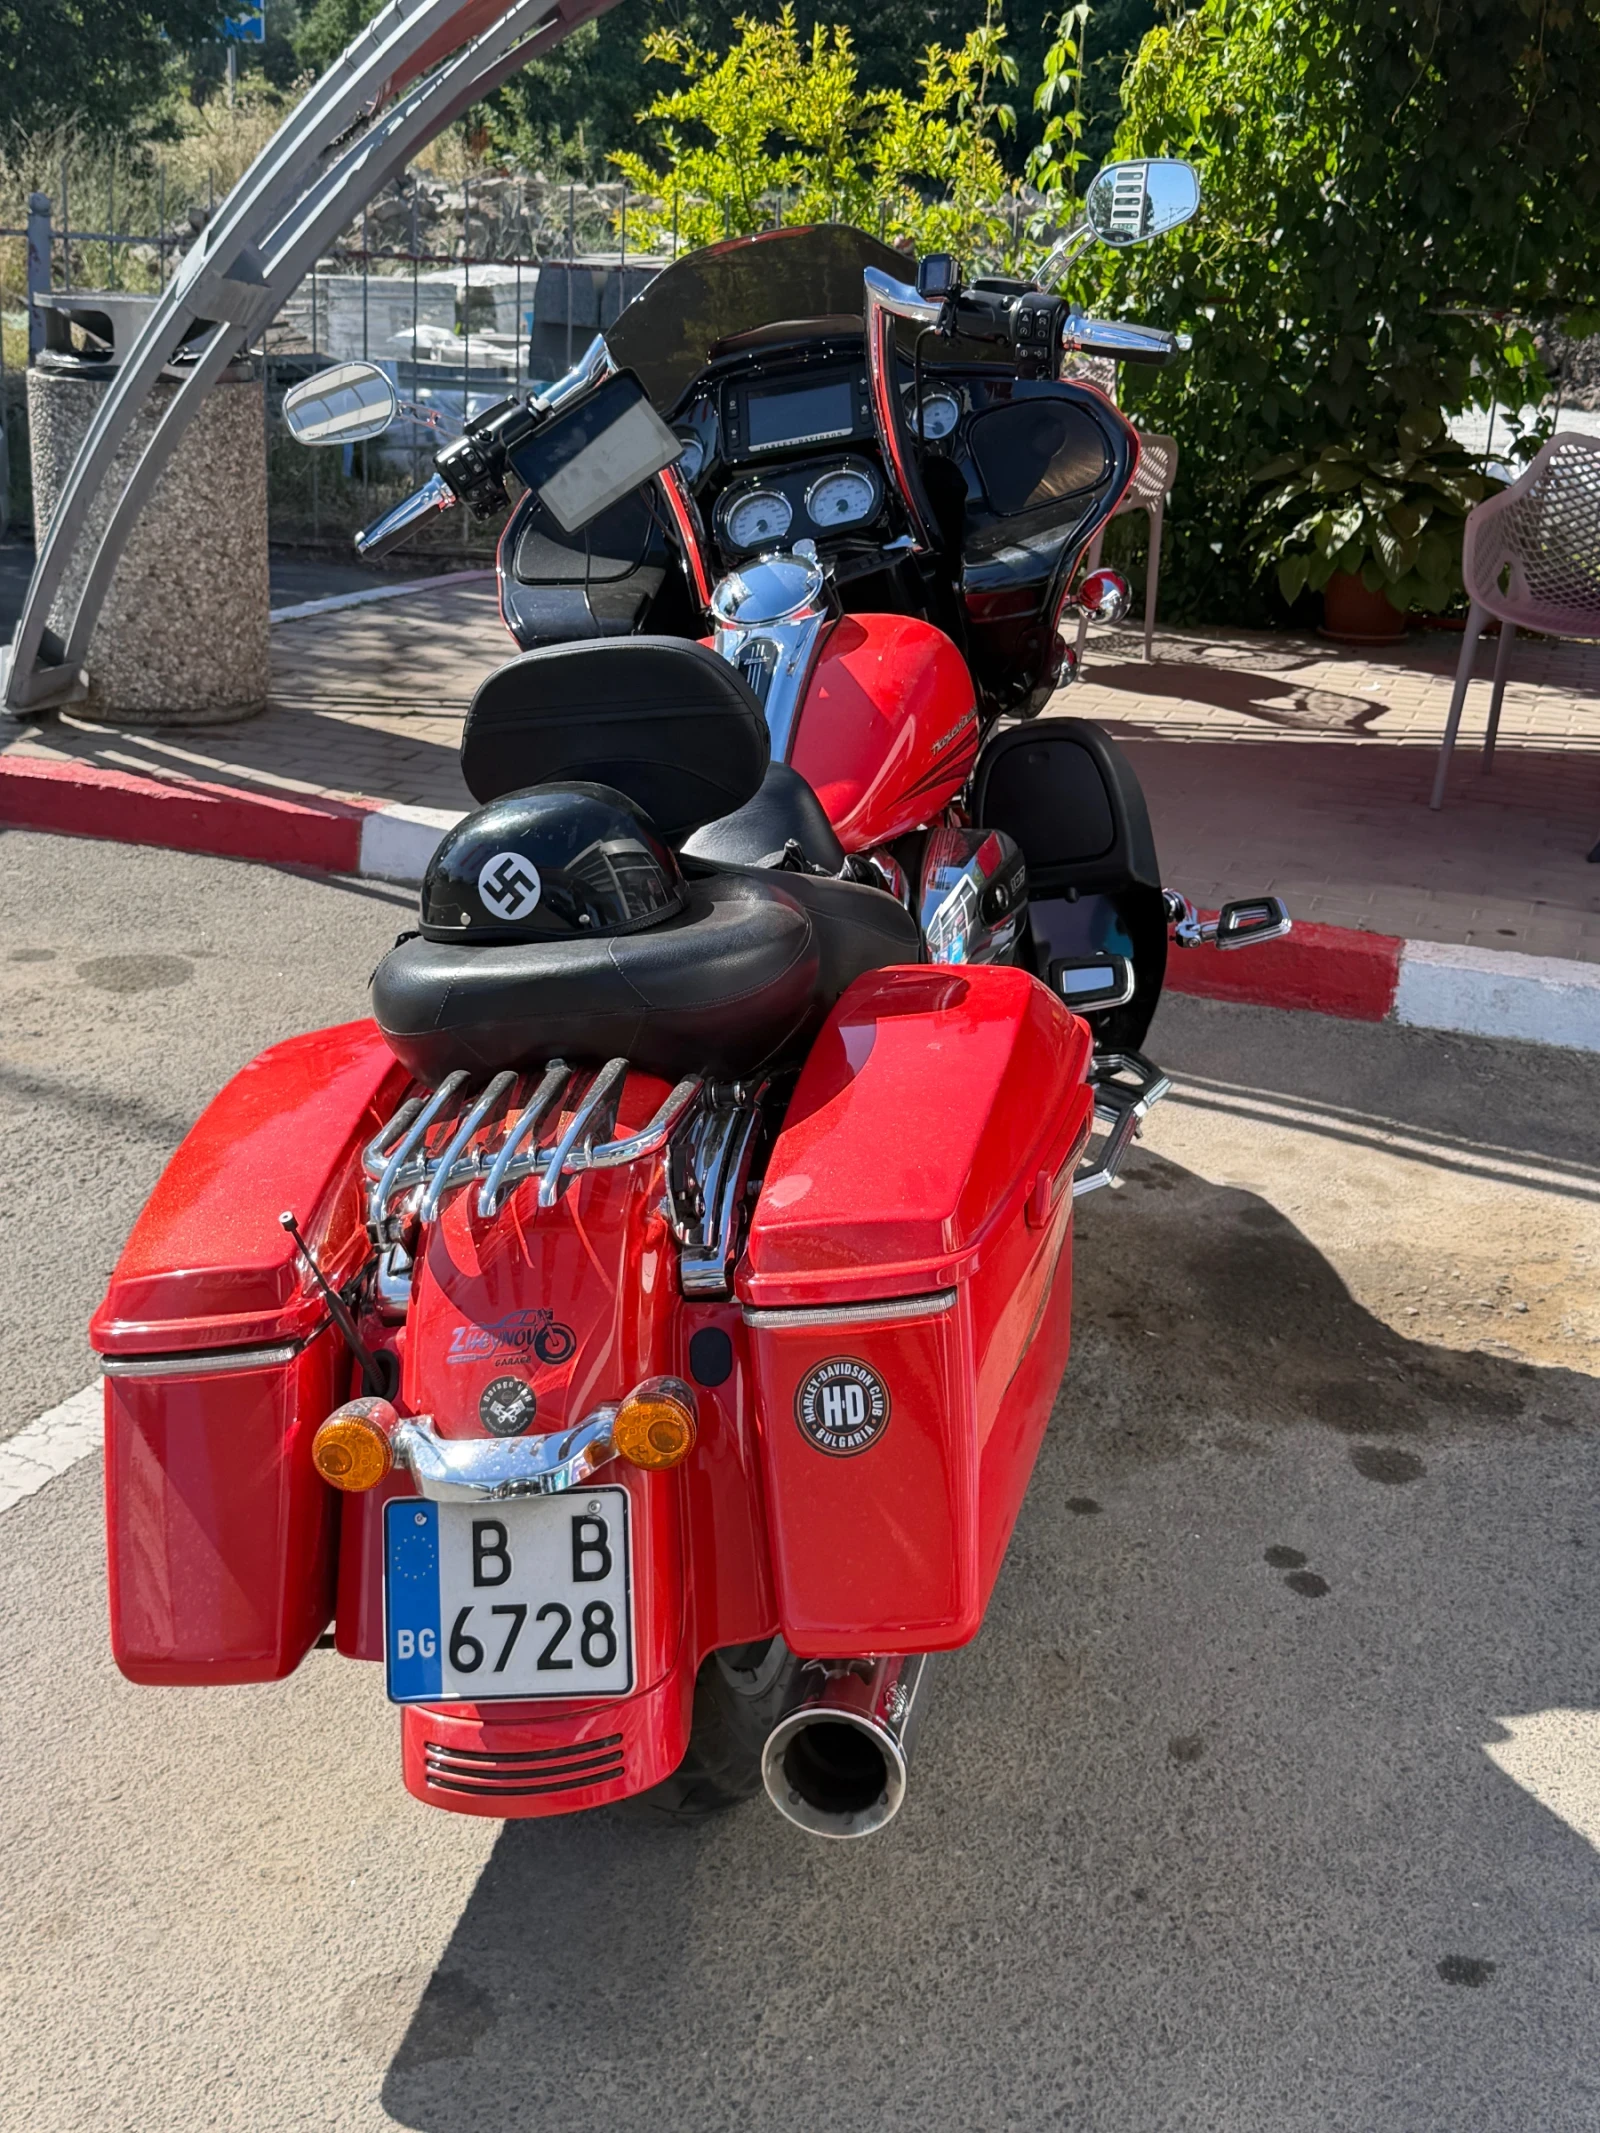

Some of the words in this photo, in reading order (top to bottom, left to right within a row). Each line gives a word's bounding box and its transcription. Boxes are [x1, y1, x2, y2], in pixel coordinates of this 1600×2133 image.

[494, 1355, 532, 1367] GARAGE
[802, 1363, 875, 1424] HARLEY-DAVIDSON
[869, 1385, 884, 1417] CLUB
[822, 1384, 865, 1427] H-D
[815, 1424, 875, 1448] BULGARIA
[472, 1519, 512, 1588] B
[571, 1514, 612, 1583] B
[397, 1627, 437, 1660] BG
[449, 1599, 617, 1674] 6728
